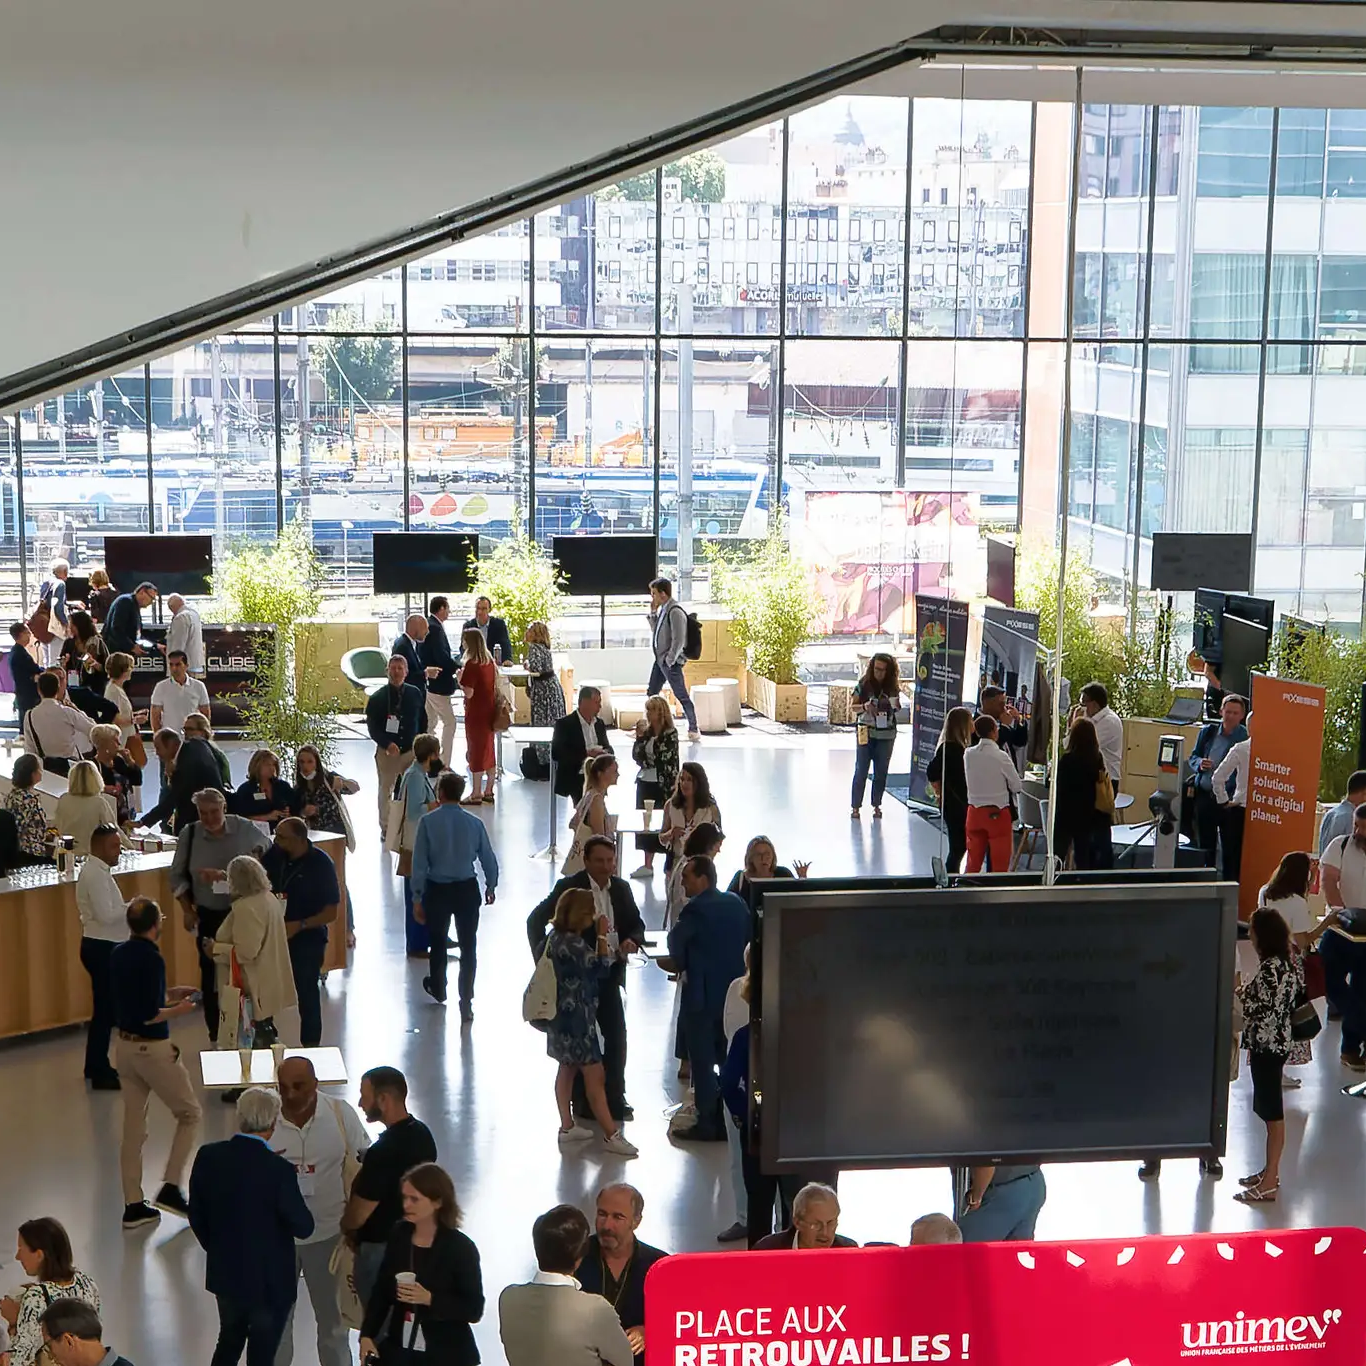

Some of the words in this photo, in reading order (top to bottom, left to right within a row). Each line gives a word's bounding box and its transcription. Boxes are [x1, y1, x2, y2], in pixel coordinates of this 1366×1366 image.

[208, 656, 256, 667] CUBE
[1255, 757, 1291, 776] Smarter
[1253, 775, 1295, 794] solutions
[1252, 790, 1266, 804] for
[1268, 797, 1274, 805] a
[1275, 795, 1305, 813] digital
[1251, 807, 1282, 826] planet.
[675, 1307, 773, 1338] PLACE
[781, 1305, 847, 1334] AUX
[1181, 1310, 1329, 1349] unimev
[961, 1333, 971, 1360] !
[1180, 1349, 1201, 1357] UNION
[1202, 1348, 1235, 1356] FRANÇAISE
[1249, 1345, 1275, 1353] MÉTIERS
